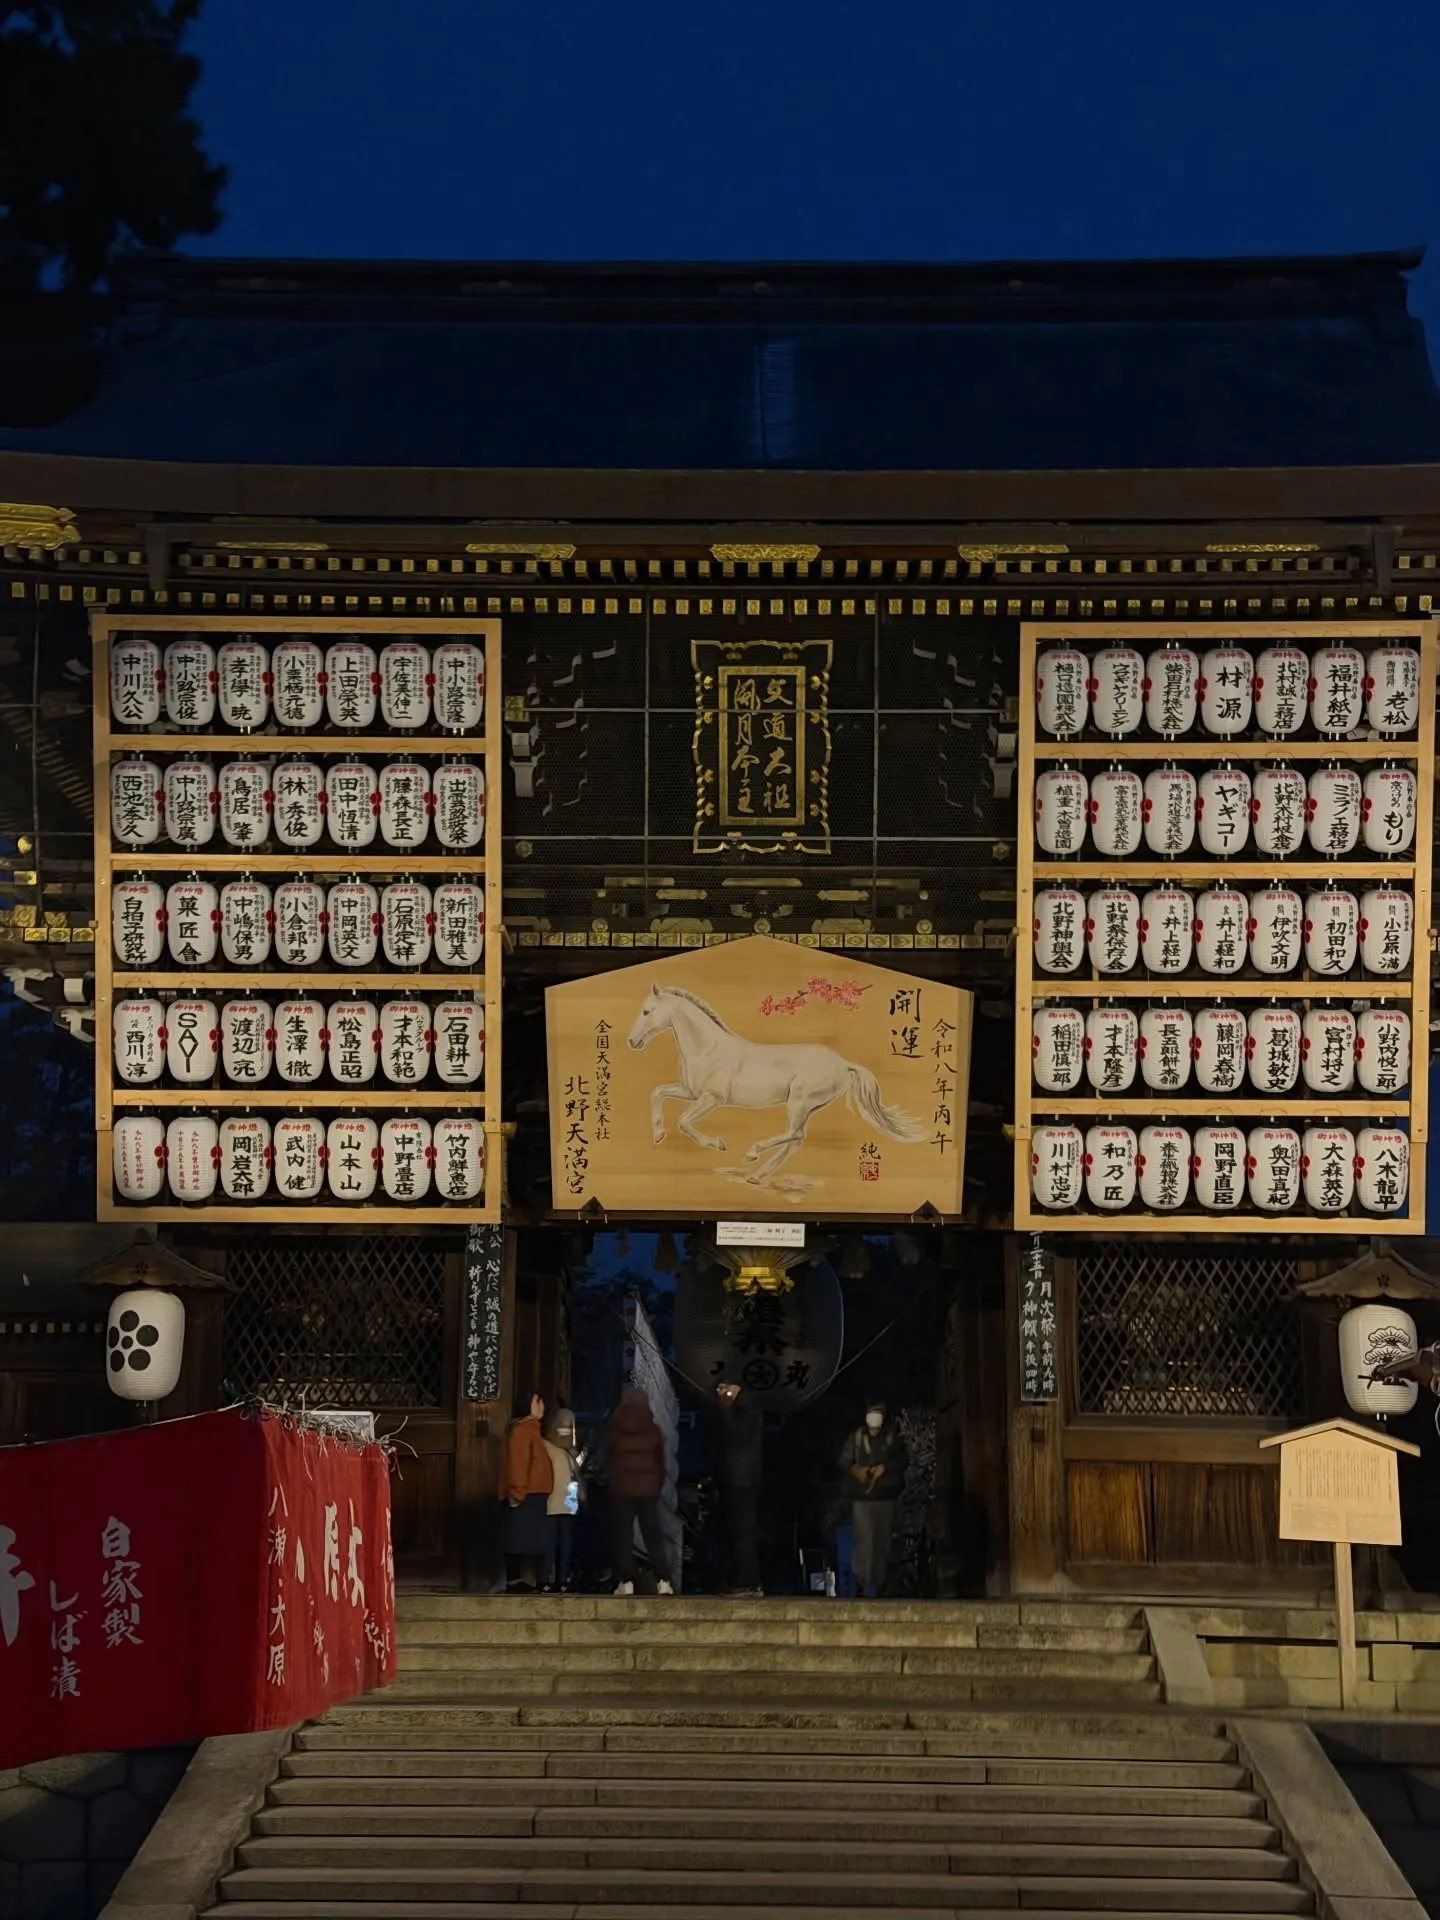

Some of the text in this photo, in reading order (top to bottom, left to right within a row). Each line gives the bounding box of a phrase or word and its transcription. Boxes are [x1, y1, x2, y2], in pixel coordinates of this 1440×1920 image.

[122, 654, 144, 719] 中川久公
[392, 657, 412, 719] 宇佐美伸二
[1273, 662, 1298, 729] 北村誠工務店
[1325, 664, 1352, 727] 福井紙店
[1382, 691, 1410, 726] 老松
[391, 777, 414, 840] 藤森長正
[1215, 785, 1239, 848] ヤギコー
[1326, 784, 1350, 849] ミラノ工務店
[1383, 811, 1403, 846] もり
[121, 896, 146, 962] 白拍子研究所
[177, 896, 202, 962] 菓匠會
[233, 896, 255, 960] 中嶋保男
[285, 896, 308, 962] 小倉邦男
[340, 898, 360, 959] 中岡英文
[393, 898, 416, 961] 石原定祥
[445, 898, 469, 960] 新田雅美
[1104, 902, 1129, 970] 北野祭保存会
[1269, 916, 1292, 969] 伊吹文明
[1323, 919, 1347, 971] 初田和久
[1378, 918, 1401, 969] 小石原満
[126, 1031, 148, 1078] 西川淳
[336, 1016, 362, 1078] 松島正昭
[391, 1015, 415, 1078] 才本和範
[443, 1016, 470, 1077] 石田耕三
[889, 988, 924, 1059] 開運
[595, 1020, 612, 1140] 全国天満宮総本社
[930, 1018, 958, 1154] 令和八年丙午
[1211, 1023, 1237, 1088] 藤岡春樹
[227, 1122, 258, 1131] 御神燈
[282, 1124, 312, 1132] 御神燈
[335, 1124, 365, 1132] 御神燈
[390, 1123, 419, 1131] 御神燈
[563, 1075, 590, 1195] 北野天満宮
[859, 1142, 881, 1160] 純
[1153, 1131, 1183, 1139] 御神燈
[1210, 1132, 1238, 1140] 御神燈
[1264, 1131, 1294, 1140] 御神燈
[1317, 1132, 1347, 1141] 御神燈
[1372, 1135, 1402, 1143] 御神燈
[231, 1136, 254, 1196] 岡岩太郎
[284, 1136, 308, 1190] 武内健
[339, 1134, 362, 1191] 山本山
[394, 1134, 415, 1196] 中野畳店
[445, 1134, 469, 1196] 竹内鮮魚店
[1048, 1143, 1072, 1204] 川村忠史
[1102, 1143, 1126, 1201] 和乃匠
[1212, 1142, 1236, 1204] 岡野直臣
[1267, 1144, 1292, 1205] 奥田真紀
[1320, 1142, 1345, 1207] 大森英治
[1374, 1149, 1400, 1210] 八木龍平
[1025, 1341, 1037, 1392] 午後四時
[1040, 1282, 1056, 1392] 月次祭 午前九時
[101, 1516, 143, 1649] 自家製
[267, 1483, 289, 1687] 八瀬・大原
[49, 1580, 88, 1700] しば漬
